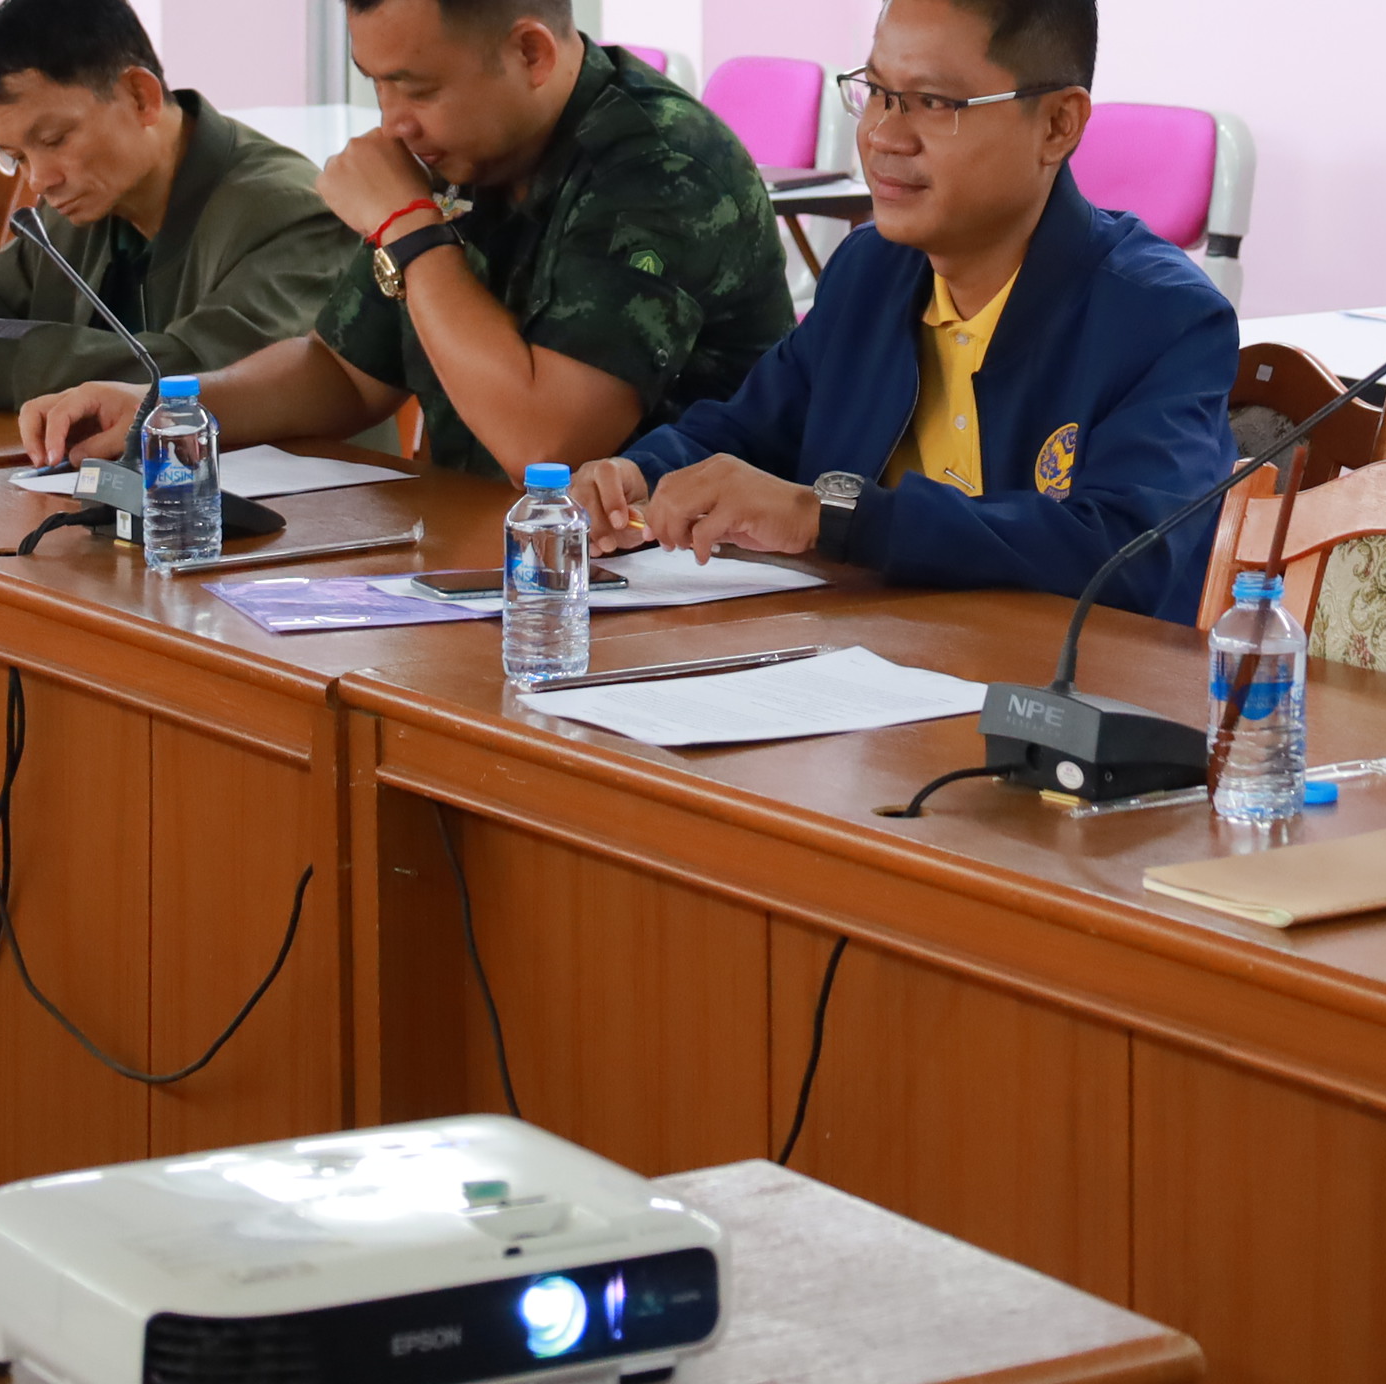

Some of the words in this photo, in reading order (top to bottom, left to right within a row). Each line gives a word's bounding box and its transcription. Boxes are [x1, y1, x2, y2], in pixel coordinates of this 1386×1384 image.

[100, 471, 126, 490] PE
[1008, 694, 1065, 727] NPE
[391, 1324, 462, 1357] EPSON
